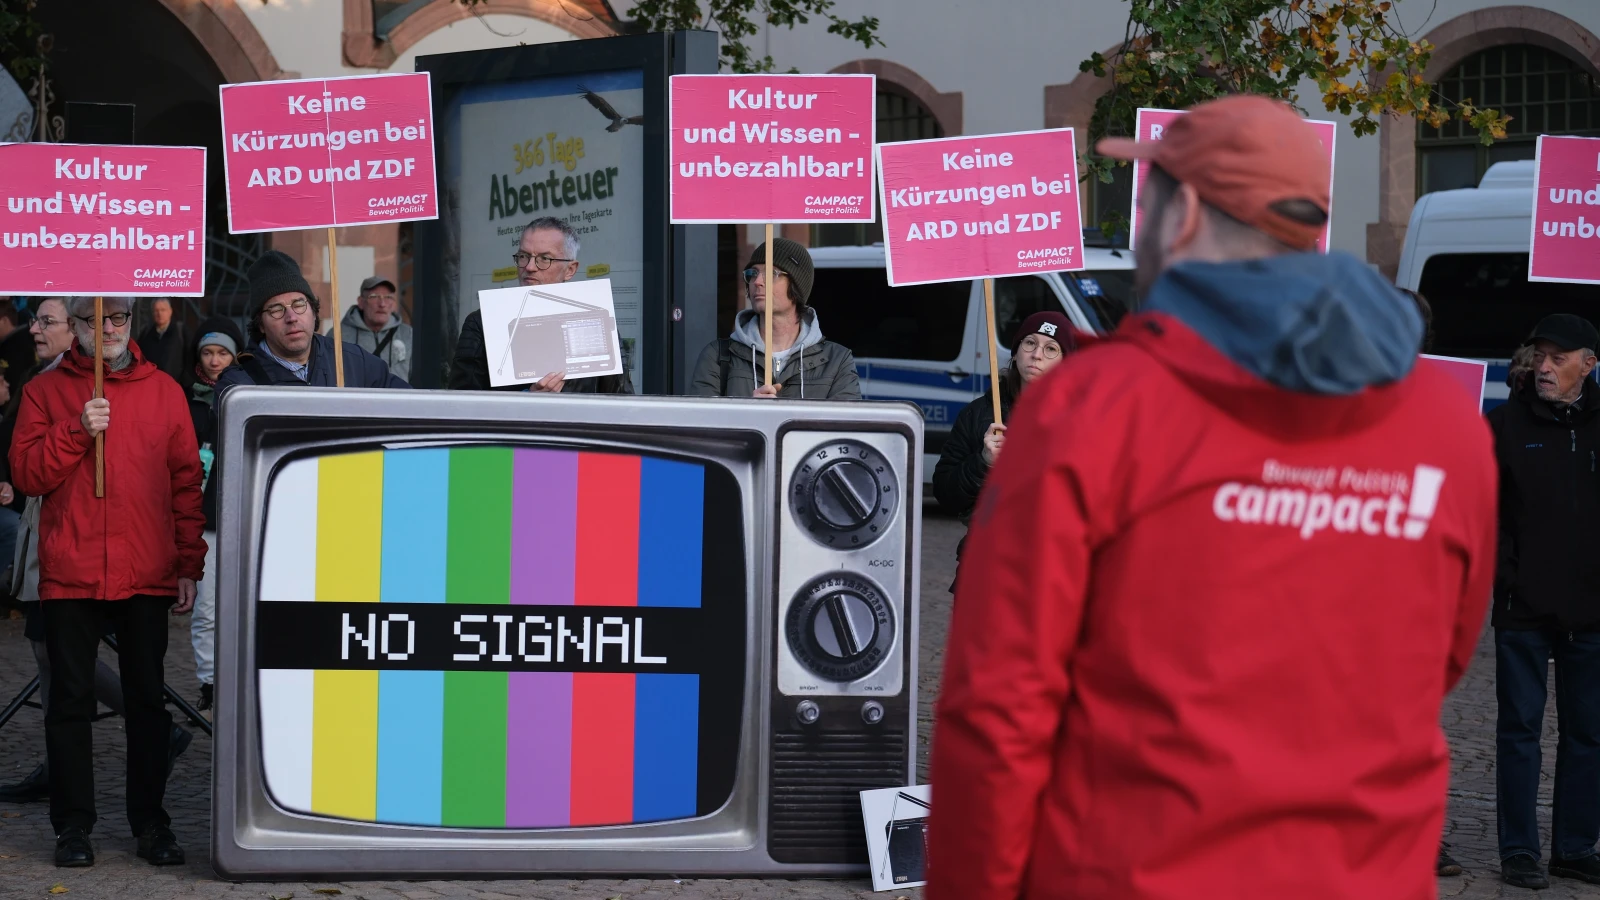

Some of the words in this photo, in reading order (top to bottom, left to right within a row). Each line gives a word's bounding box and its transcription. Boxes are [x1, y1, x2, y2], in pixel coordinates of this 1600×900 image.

[288, 92, 366, 115] Keine
[728, 87, 818, 109] Kultur
[232, 127, 378, 152] Kürzungen
[384, 119, 426, 142] bei
[684, 121, 735, 144] und
[742, 121, 841, 144] Wissen
[513, 137, 545, 174] 366
[546, 132, 585, 172] Tage
[942, 149, 1013, 171] Keine
[55, 157, 148, 180] Kultur
[247, 166, 302, 188] ARD
[308, 160, 361, 184] und
[366, 158, 415, 180] ZDF
[679, 155, 864, 177] unbezahlbar!
[368, 194, 428, 207] CAMPACT
[489, 166, 618, 221] Abenteuer
[804, 196, 864, 206] CAMPACT
[891, 184, 1026, 208] Kürzungen
[1031, 173, 1070, 196] bei
[8, 192, 62, 213] und
[69, 192, 172, 215] Wissen
[369, 207, 398, 216] Bewegt
[400, 205, 424, 214] Politik
[804, 207, 834, 216] Bewegt
[570, 213, 581, 223] Ihre
[582, 208, 612, 222] Tageskarte
[906, 220, 958, 242] ARD
[963, 213, 1010, 236] und
[1015, 211, 1061, 232] ZDF
[3, 226, 195, 250] unbezahlbar!
[497, 226, 513, 236] Heute
[1017, 246, 1074, 260] CAMPACT
[1018, 259, 1046, 268] Bewegt
[1048, 257, 1071, 265] Politik
[133, 268, 194, 279] CAMPACT
[133, 280, 164, 288] Bewegt
[817, 450, 828, 460] 12
[802, 464, 812, 474] 11
[1262, 459, 1336, 491] Bewegt
[1340, 465, 1409, 495] Politik
[795, 484, 803, 496] 10
[1212, 463, 1446, 540] campact!
[869, 524, 878, 532] 5
[341, 613, 415, 660] NO
[453, 615, 667, 664] SIGNAL
